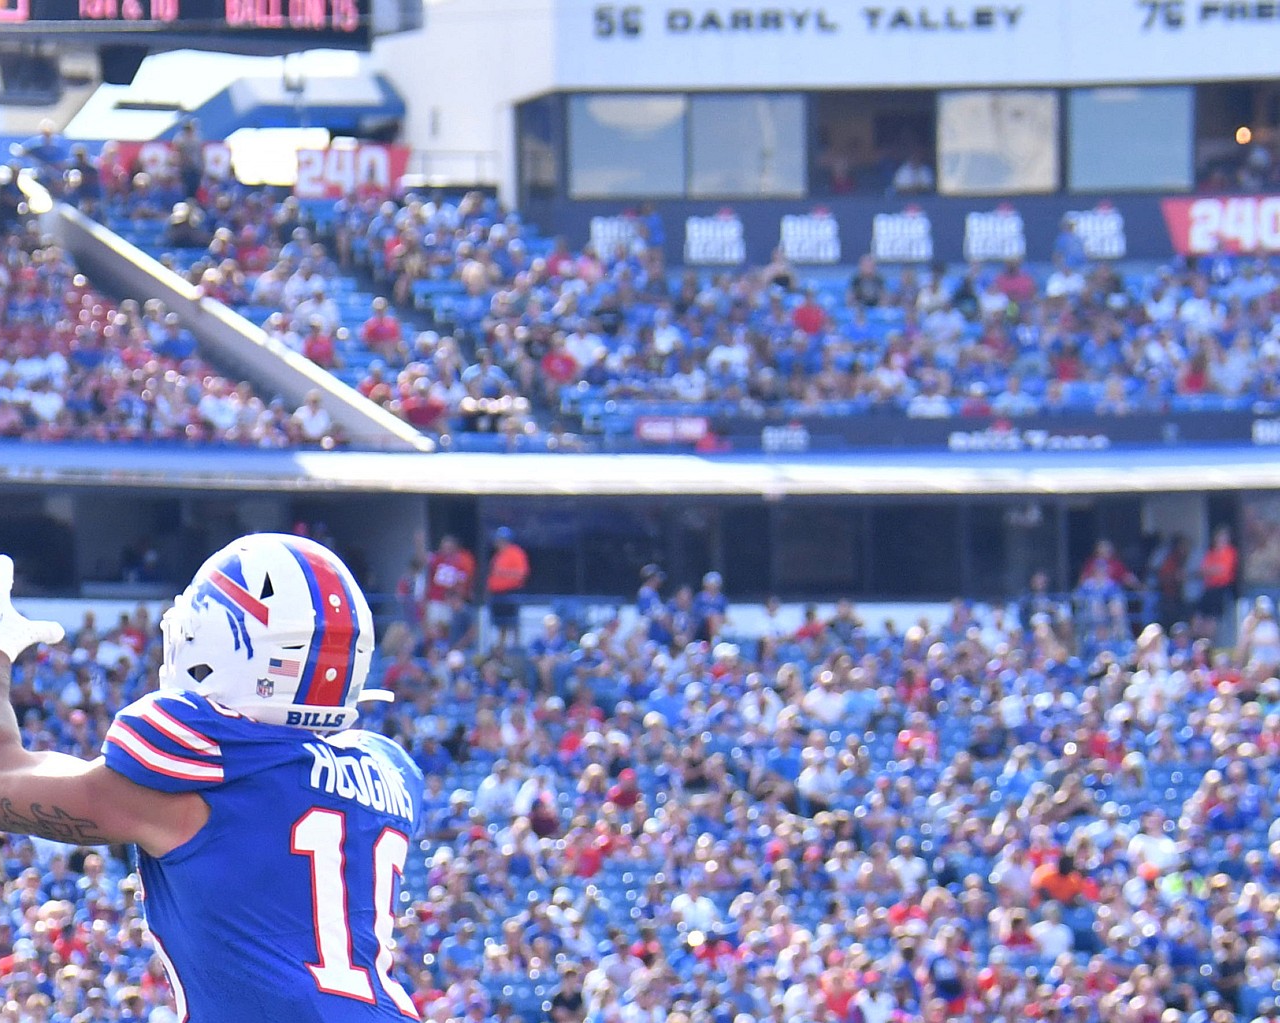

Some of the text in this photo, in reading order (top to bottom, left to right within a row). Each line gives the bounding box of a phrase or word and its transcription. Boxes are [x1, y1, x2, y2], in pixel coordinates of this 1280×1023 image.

[595, 5, 1023, 37] 56 DARRYL TALLEY
[285, 710, 346, 728] BILLS
